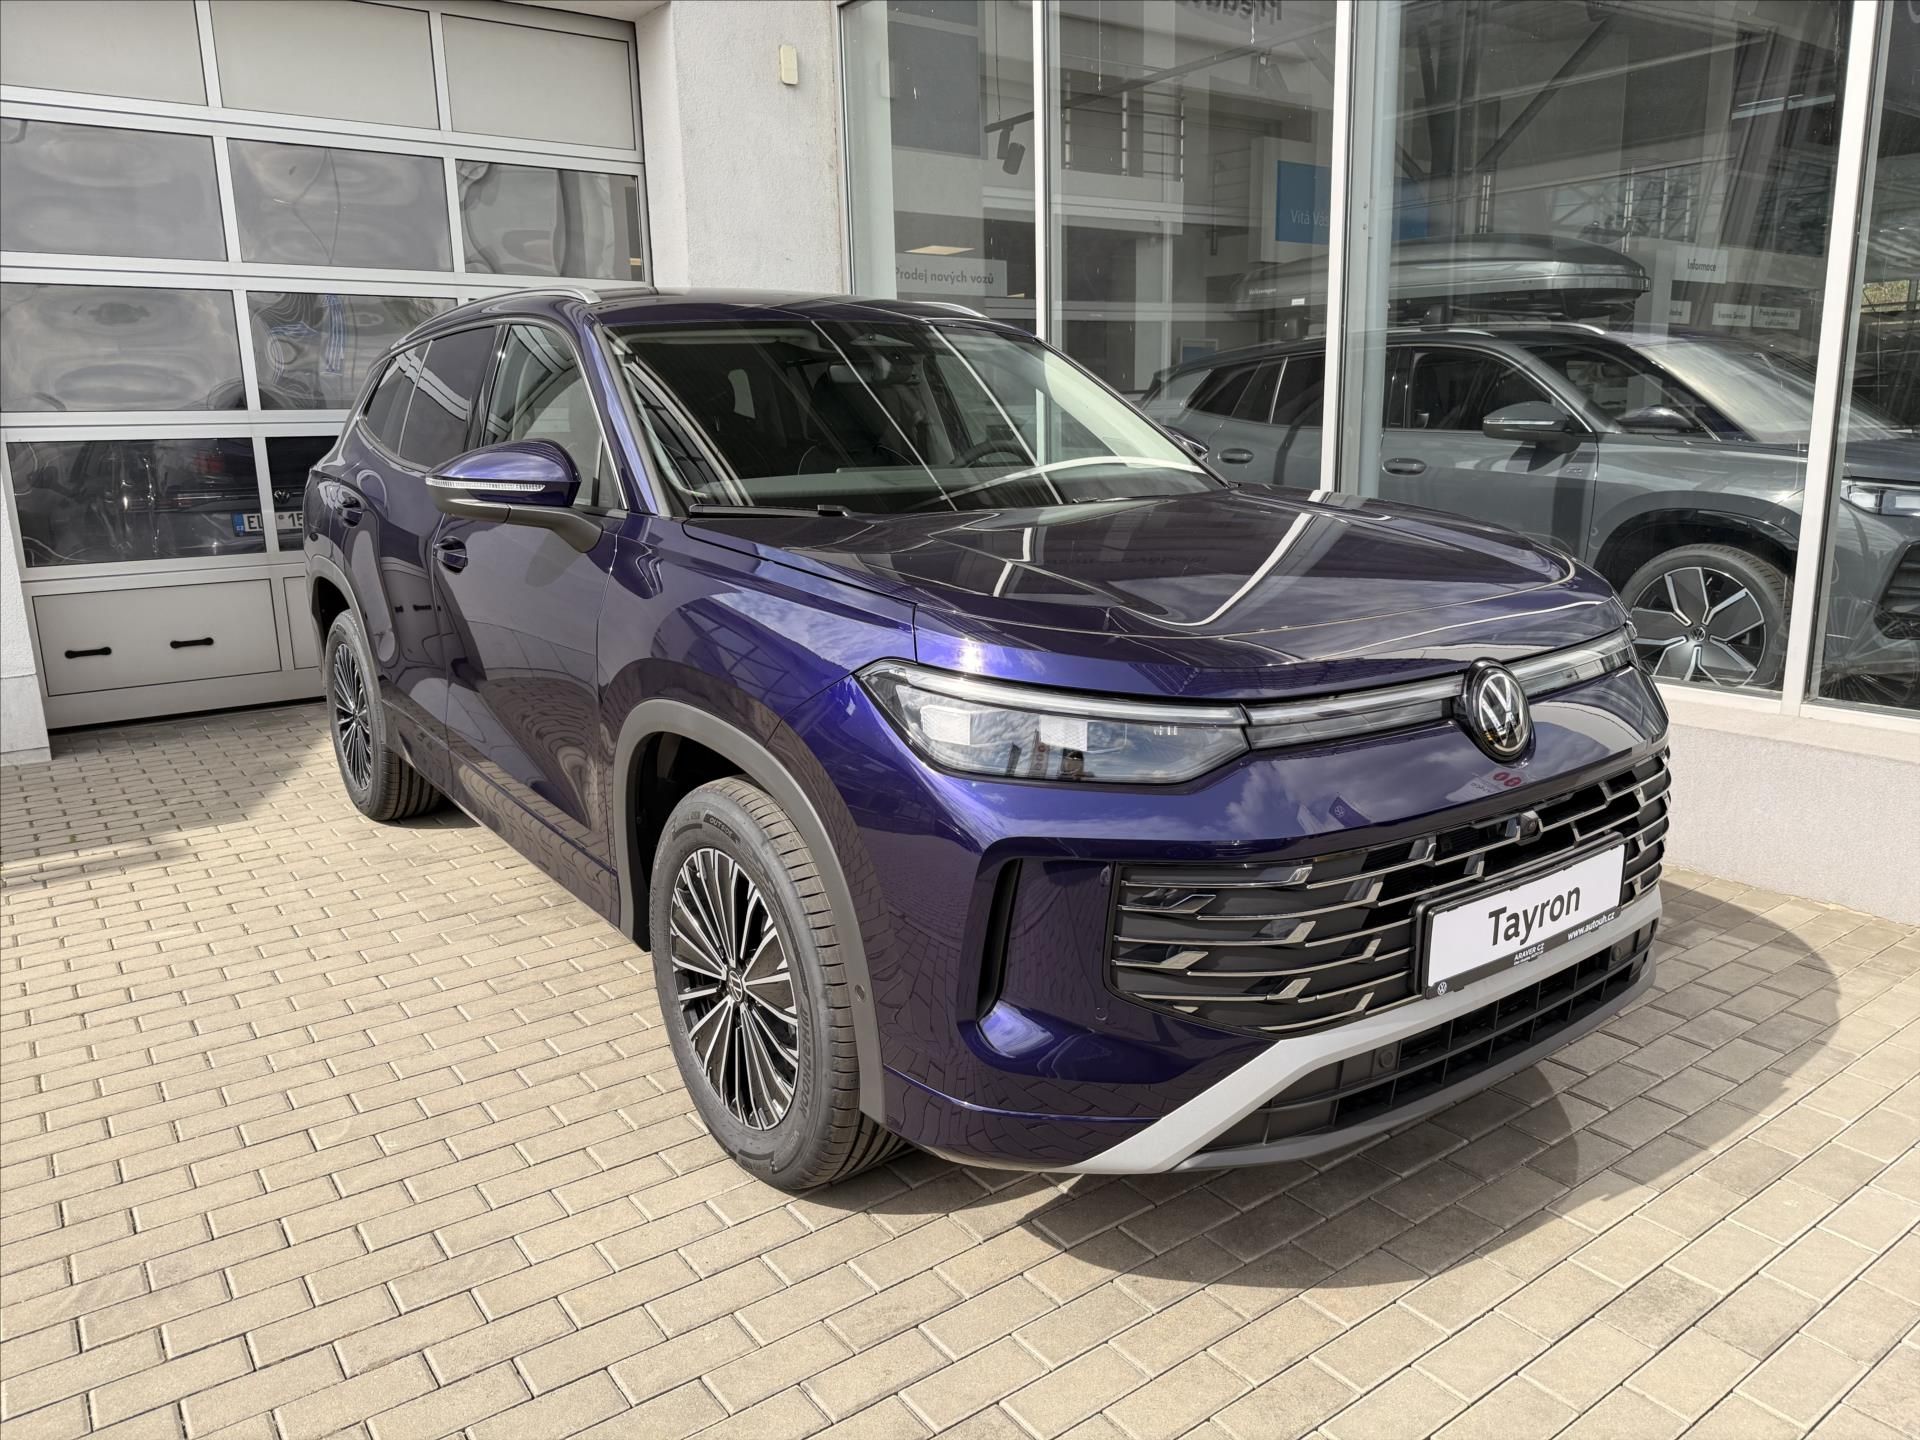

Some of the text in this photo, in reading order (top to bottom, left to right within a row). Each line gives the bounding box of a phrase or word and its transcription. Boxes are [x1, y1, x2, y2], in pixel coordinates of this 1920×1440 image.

[1687, 258, 1717, 272] Informace
[930, 270, 967, 285] nových
[970, 272, 994, 285] vozů
[1488, 886, 1581, 946] Tayron
